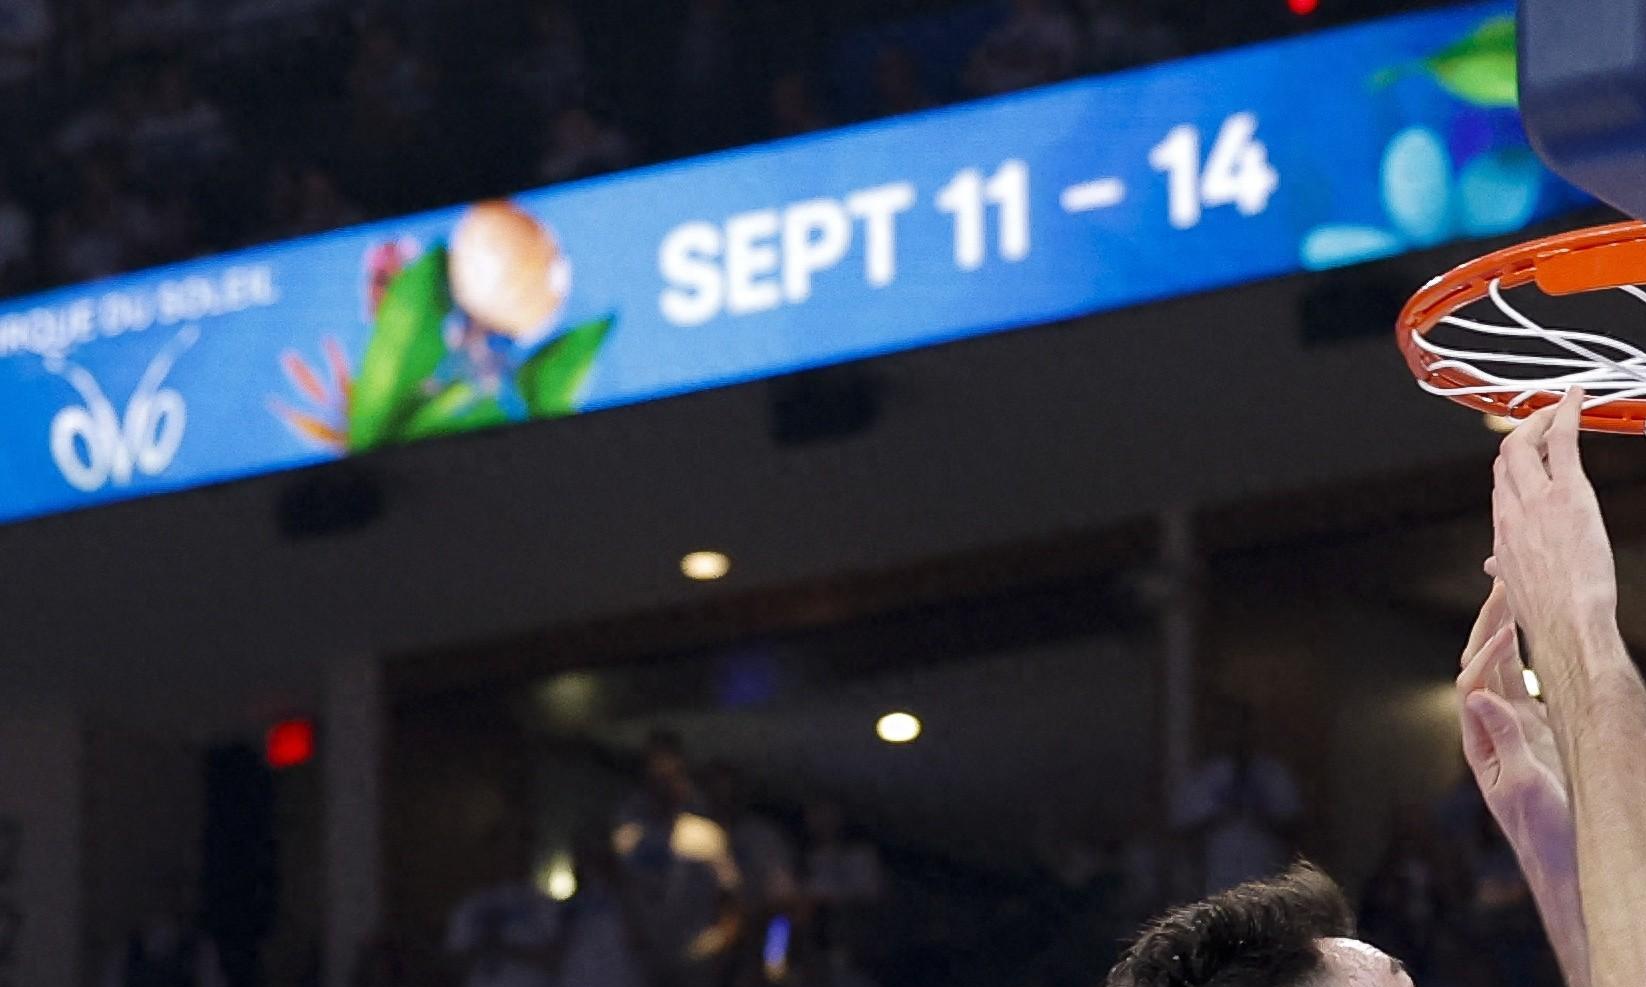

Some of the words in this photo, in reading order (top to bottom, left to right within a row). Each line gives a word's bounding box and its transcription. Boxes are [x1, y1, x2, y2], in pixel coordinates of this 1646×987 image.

[658, 180, 917, 327] SEPT
[935, 157, 1030, 271] 11
[1148, 111, 1280, 231] 14
